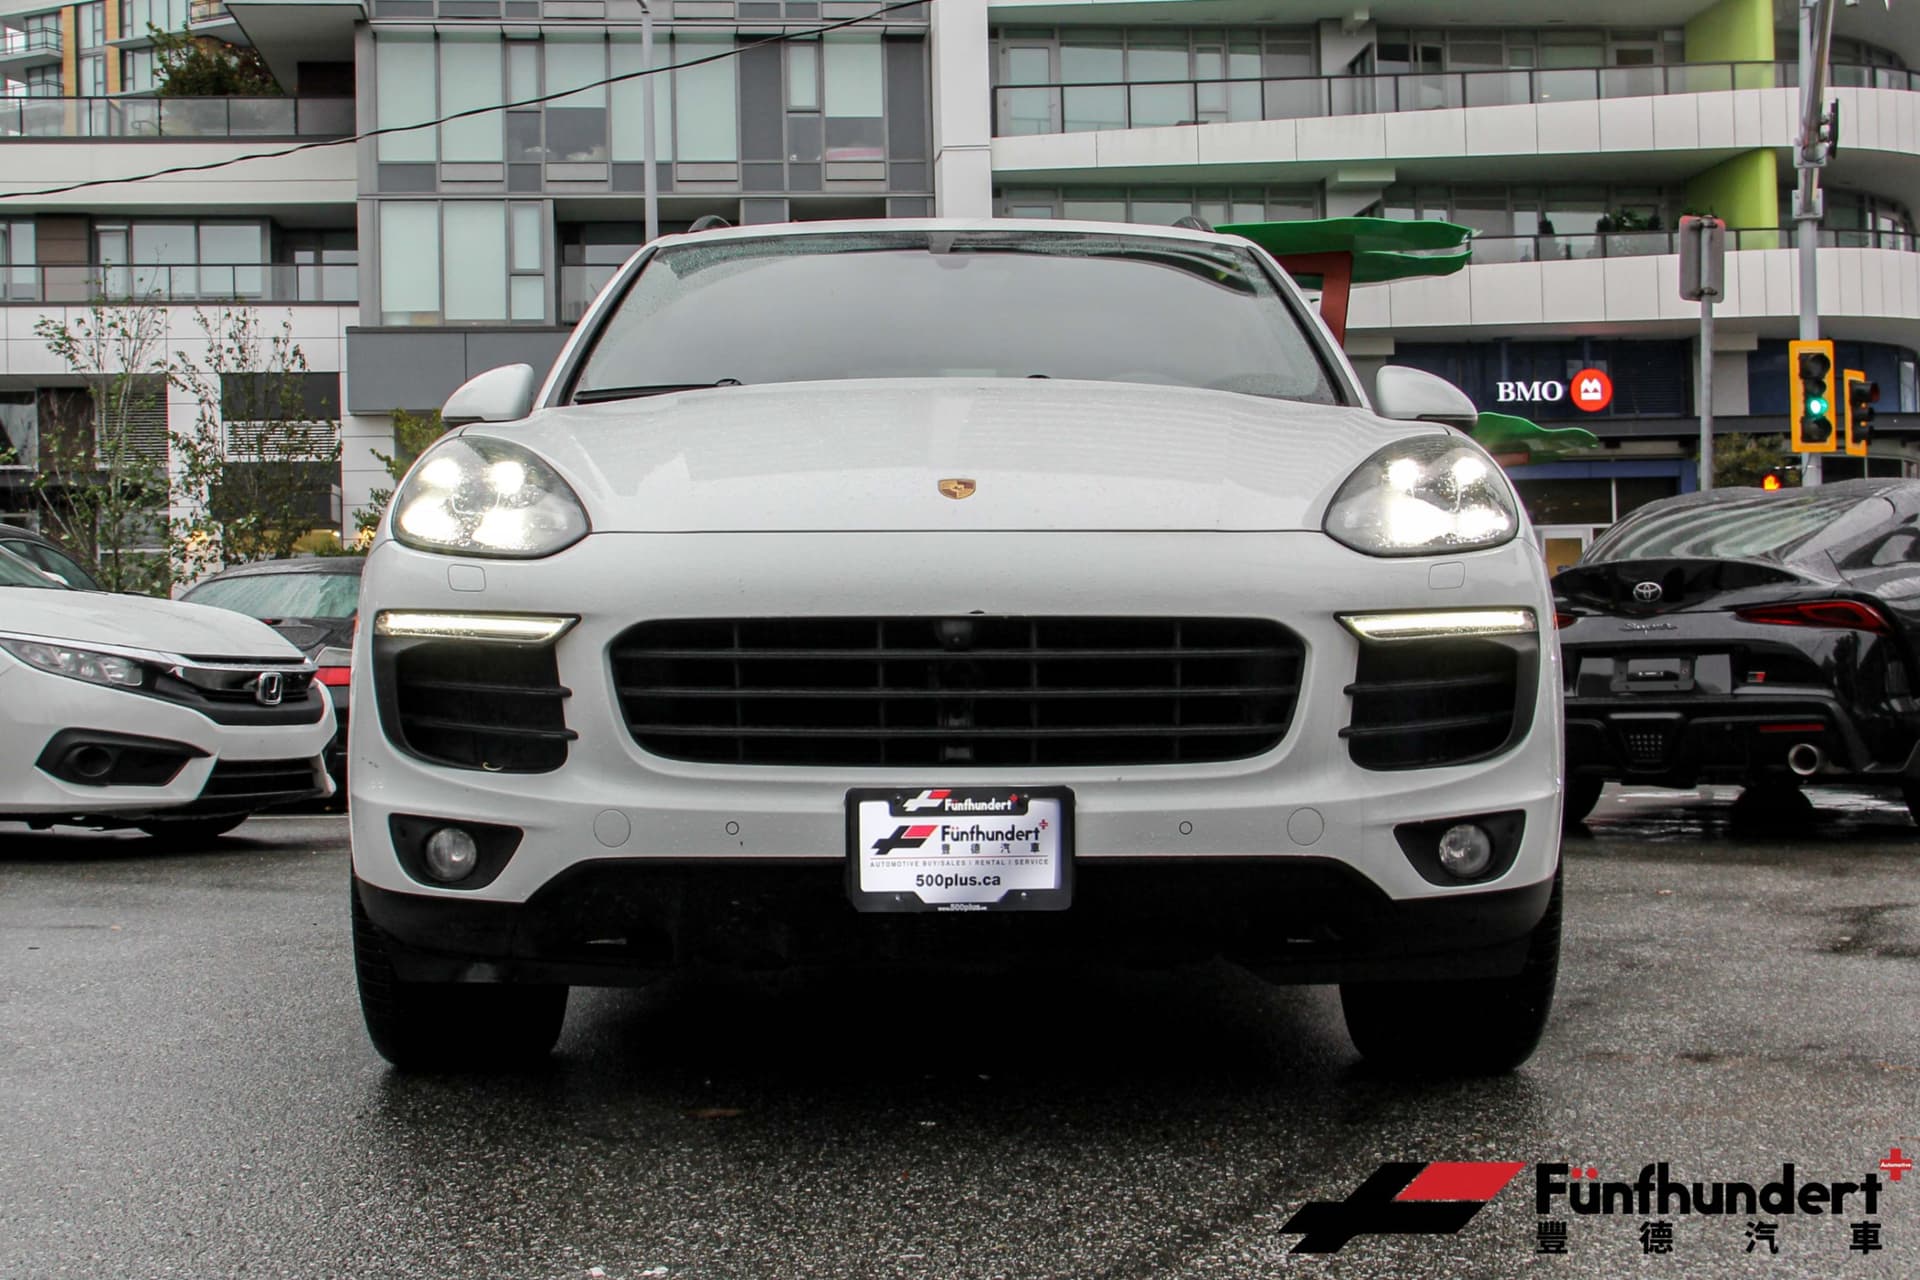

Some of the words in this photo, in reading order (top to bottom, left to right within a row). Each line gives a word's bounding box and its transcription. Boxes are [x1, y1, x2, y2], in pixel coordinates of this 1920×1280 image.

[1496, 381, 1564, 402] BMO
[941, 825, 1040, 842] Fünfhundert
[870, 860, 919, 868] AUTOMOTIVE
[1014, 858, 1049, 866] SERVICE
[915, 873, 1001, 889] 500plus.ca
